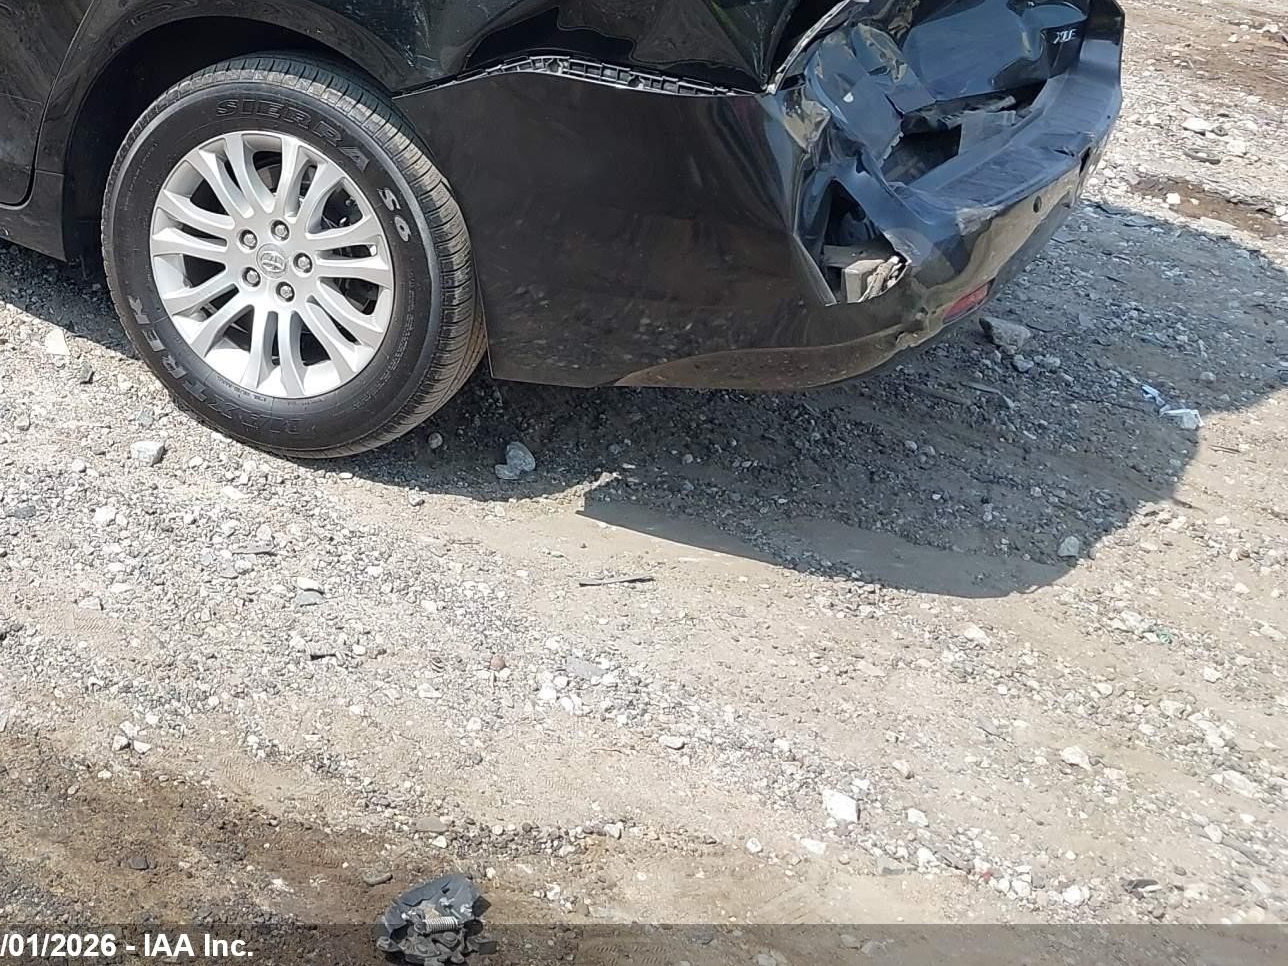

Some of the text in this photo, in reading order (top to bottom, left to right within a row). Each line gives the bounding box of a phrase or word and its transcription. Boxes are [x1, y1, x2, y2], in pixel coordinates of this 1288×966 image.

[1053, 28, 1078, 44] XLE
[215, 99, 413, 243] SIERRA S6
